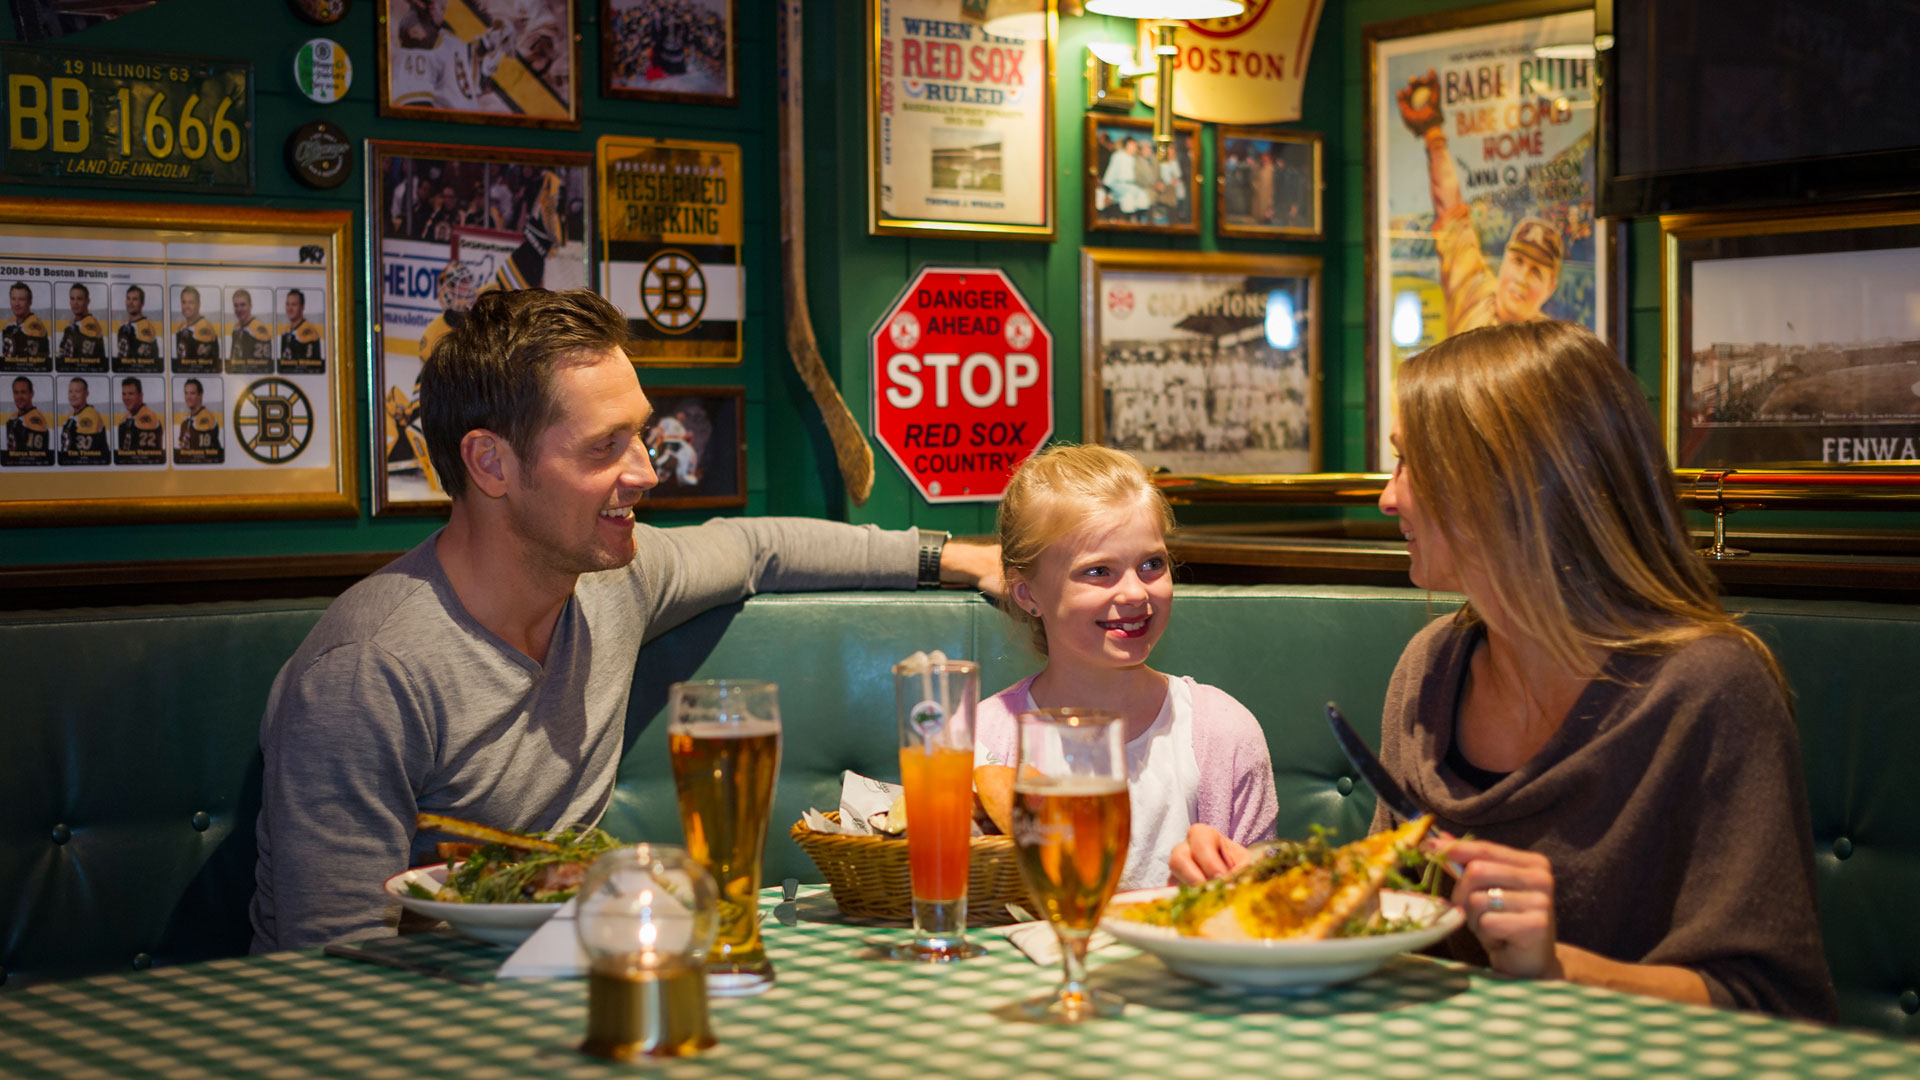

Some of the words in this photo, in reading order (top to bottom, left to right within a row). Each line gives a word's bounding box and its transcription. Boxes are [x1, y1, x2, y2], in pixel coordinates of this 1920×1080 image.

[902, 17, 973, 40] WHEN
[64, 60, 84, 75] 19
[91, 61, 162, 80] ILLINOIS
[169, 67, 191, 83] 63
[902, 38, 963, 81] RED
[969, 46, 1024, 86] SOX
[1173, 44, 1285, 81] BOSTON
[926, 84, 1004, 105] RULED
[1445, 64, 1506, 104] BABE
[8, 74, 91, 153] BB
[116, 88, 242, 163] 1666
[1482, 131, 1544, 162] HOME
[66, 159, 107, 175] LAND
[109, 161, 129, 176] OF
[130, 162, 191, 179] LINCOLN
[616, 173, 727, 205] RESERVED
[626, 204, 719, 236] PARKING
[0, 267, 41, 277] 2008-09
[43, 268, 75, 278] Boston
[77, 269, 109, 279] Bruins
[917, 289, 1009, 310] DANGER
[1146, 292, 1268, 318] CHAMPIONS
[926, 316, 1001, 336] AHEAD
[885, 352, 1040, 409] STOP
[904, 423, 961, 448] RED
[969, 421, 1028, 447] SOX
[914, 452, 1018, 475] COUNTRY
[1822, 437, 1920, 464] FENWA
